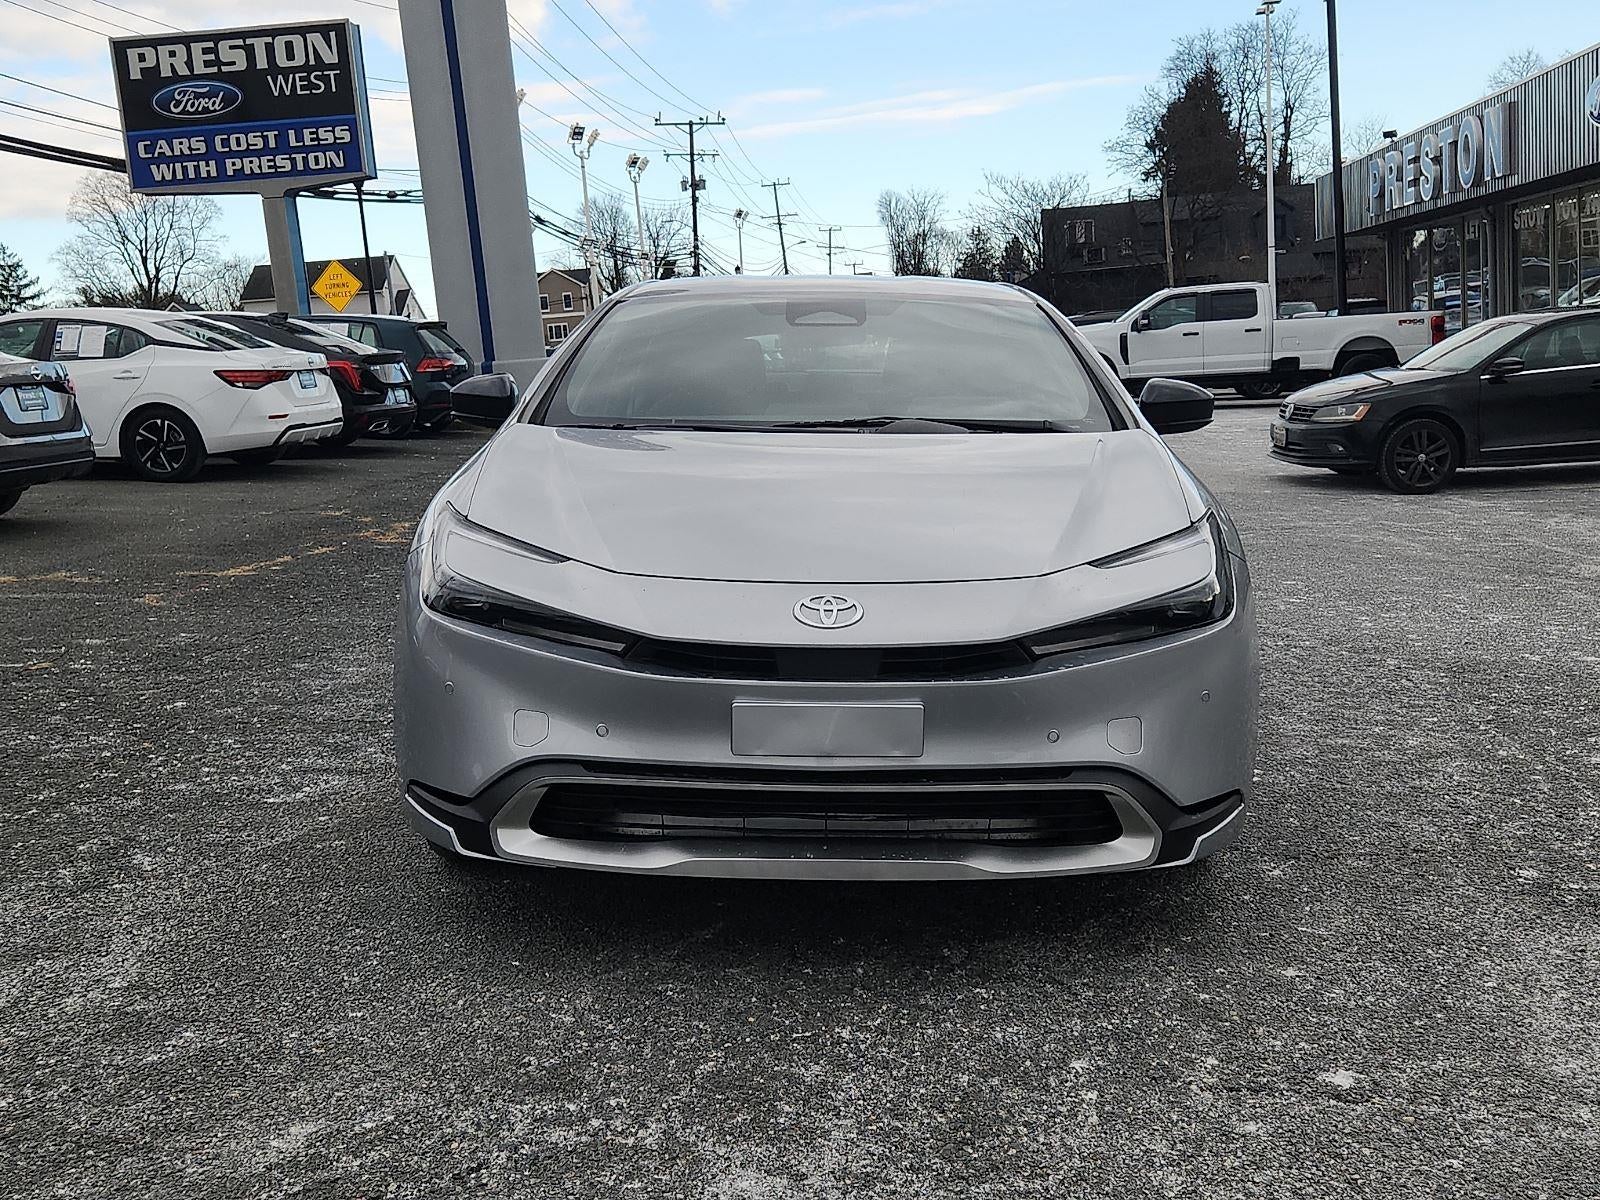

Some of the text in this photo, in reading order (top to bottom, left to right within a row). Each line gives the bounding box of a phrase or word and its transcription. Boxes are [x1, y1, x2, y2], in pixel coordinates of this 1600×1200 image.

[126, 31, 339, 80] PRESTON
[267, 70, 341, 97] WEST
[169, 86, 225, 113] Ford
[137, 125, 351, 159] CARS COST LESS
[150, 150, 345, 182] WITH PRESTON
[1369, 103, 1510, 216] PRESTON
[1513, 204, 1546, 230] SHOW
[324, 281, 350, 290] TURNING
[324, 290, 352, 299] VEHICLES
